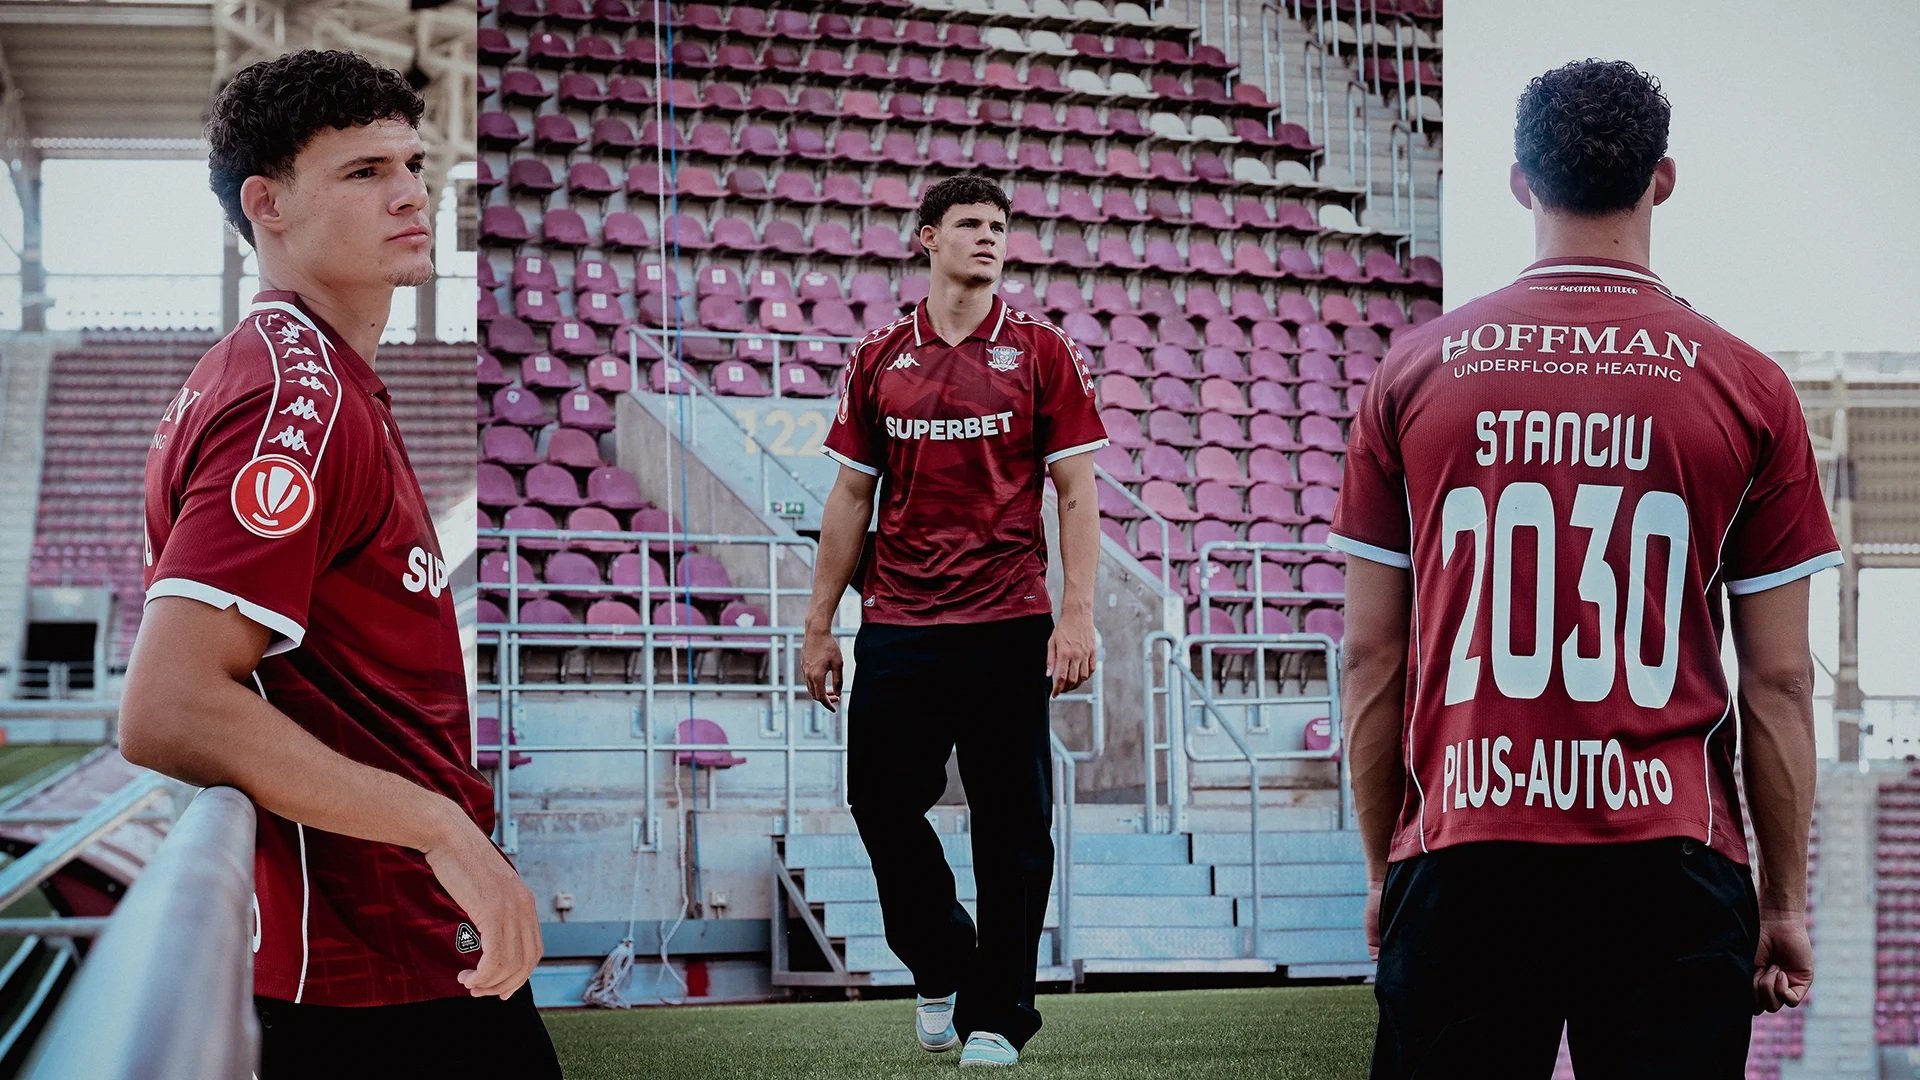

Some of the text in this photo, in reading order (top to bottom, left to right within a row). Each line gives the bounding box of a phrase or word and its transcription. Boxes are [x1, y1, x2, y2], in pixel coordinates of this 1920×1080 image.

[1604, 286, 1639, 295] TUTUROR
[1442, 323, 1702, 368] HOFFMAN
[1454, 359, 1682, 382] UNDERFLOOR HEATING
[735, 408, 827, 457] 122
[885, 411, 1014, 440] SUPERBET
[1476, 410, 1653, 471] STANCIU
[1441, 481, 1690, 709] 2030
[1442, 735, 1673, 813] PLUS-AUTO.ro
